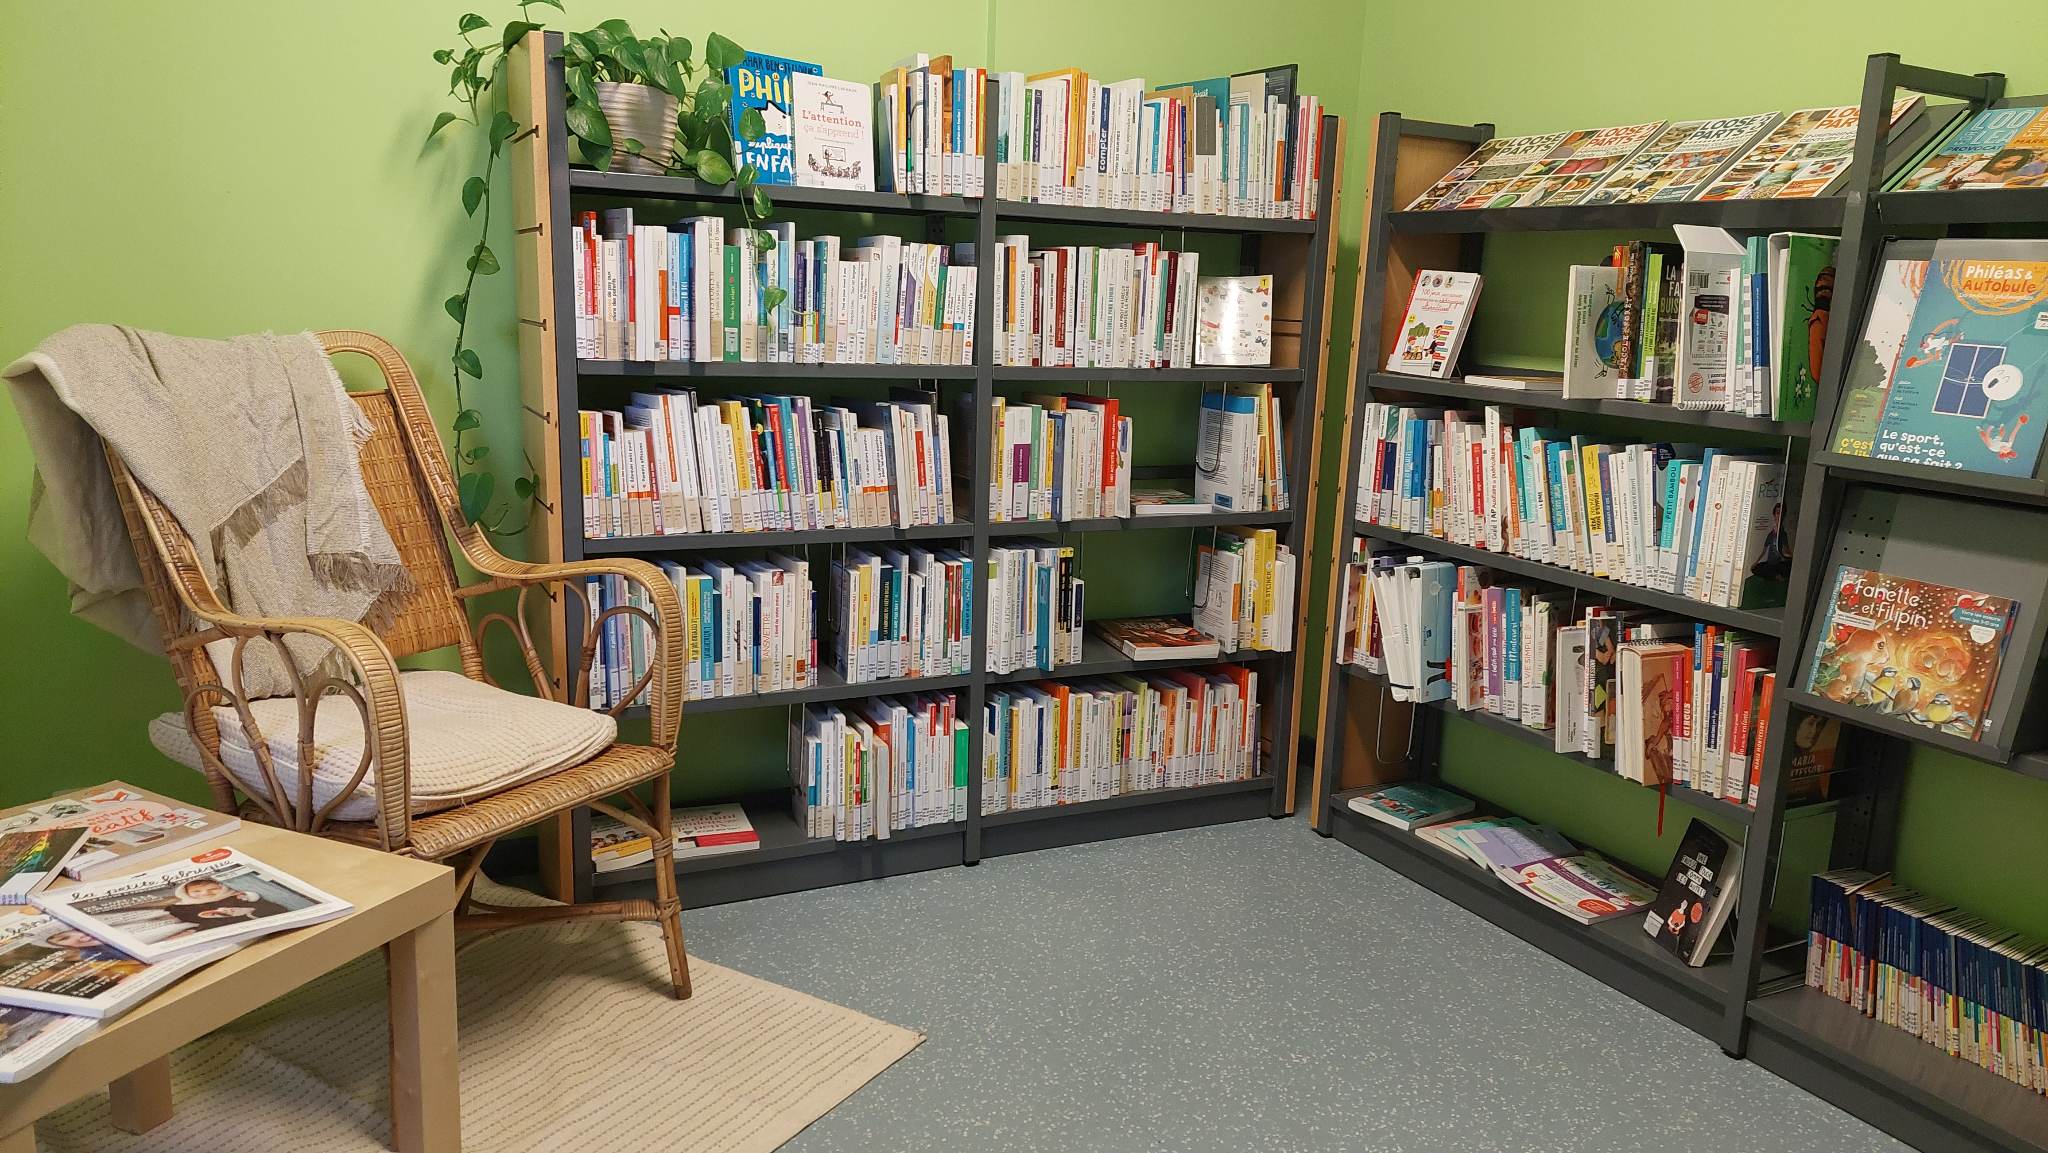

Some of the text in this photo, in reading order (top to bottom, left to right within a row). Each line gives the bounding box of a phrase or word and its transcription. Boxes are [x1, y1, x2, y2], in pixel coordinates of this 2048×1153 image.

[1595, 124, 1643, 138] LOOSE
[1691, 127, 1744, 140] PARTS
[1700, 116, 1759, 131] LOOSE
[1098, 127, 1108, 171] compter
[1586, 136, 1634, 147] PARTS
[885, 265, 893, 298] MORNING
[1879, 442, 1946, 458] qu'est-ce
[1882, 429, 1944, 446] Le sport,
[1665, 466, 1677, 520] PETIT BAMBOU
[1490, 508, 1497, 518] AP
[1854, 578, 1920, 607] Fanette
[1861, 604, 1876, 614] et
[1877, 603, 1928, 628] Filipin
[761, 611, 770, 659] ANSMETTRE
[1683, 702, 1691, 736] CIRCUS
[1753, 719, 1766, 770] MARIA MONTESSORI
